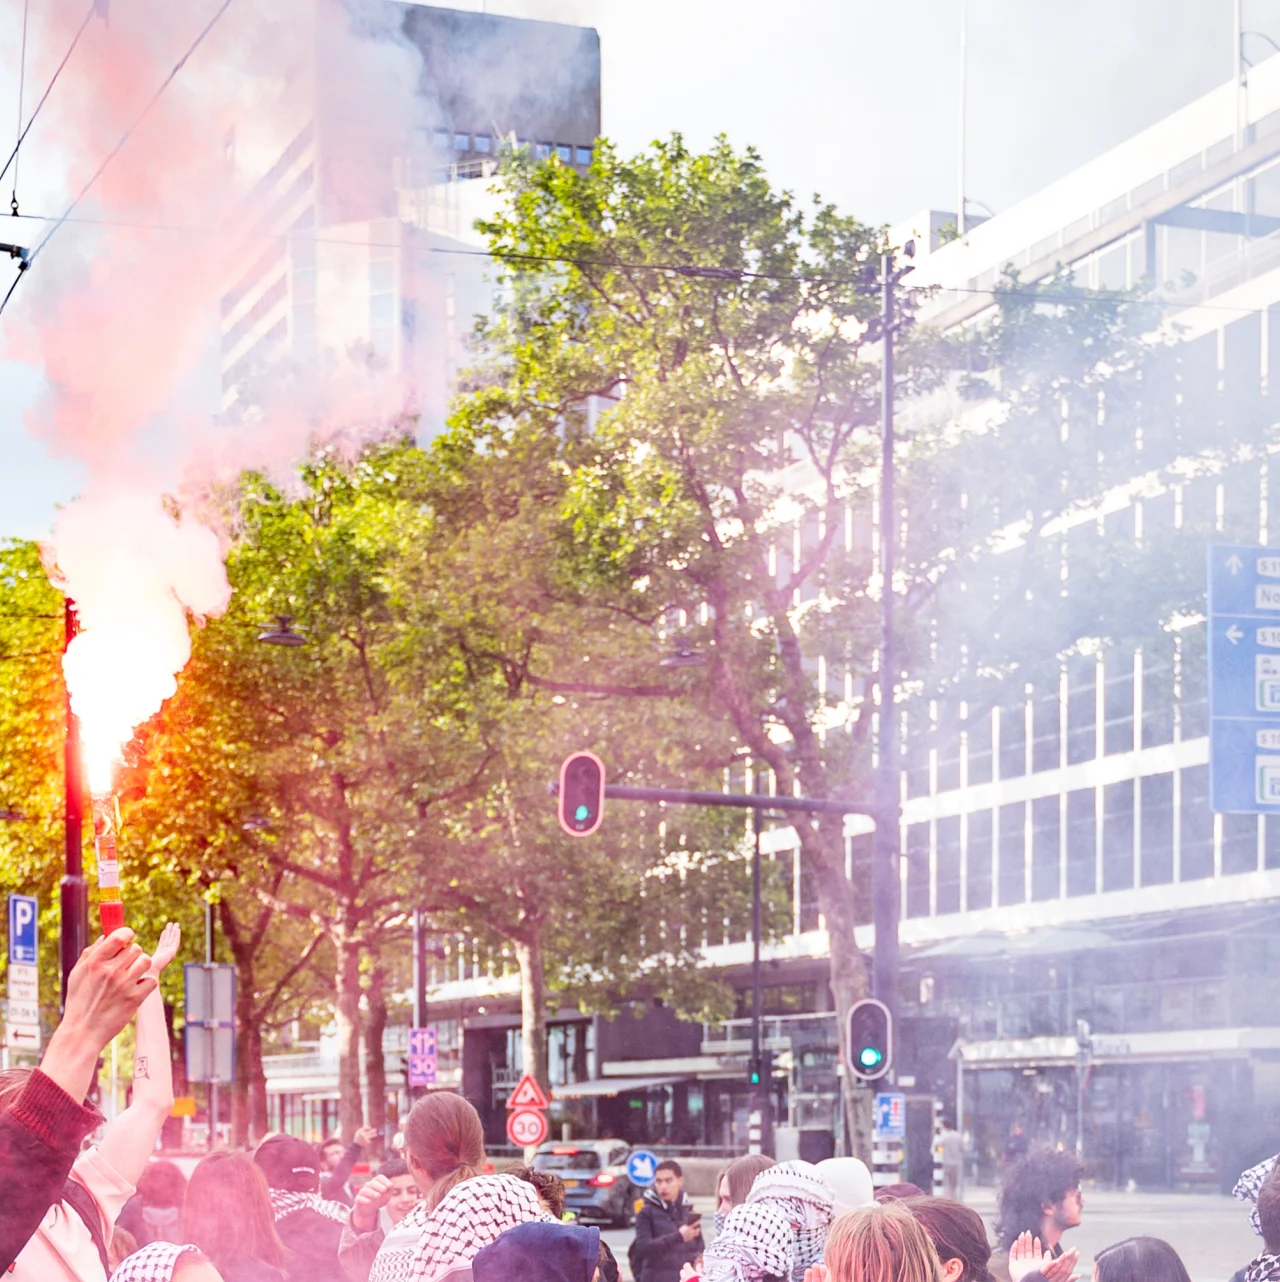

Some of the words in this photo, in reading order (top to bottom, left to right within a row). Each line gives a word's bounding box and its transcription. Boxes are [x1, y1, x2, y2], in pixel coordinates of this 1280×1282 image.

[16, 900, 33, 936] P
[411, 1058, 436, 1075] 30
[515, 1122, 540, 1136] 30
